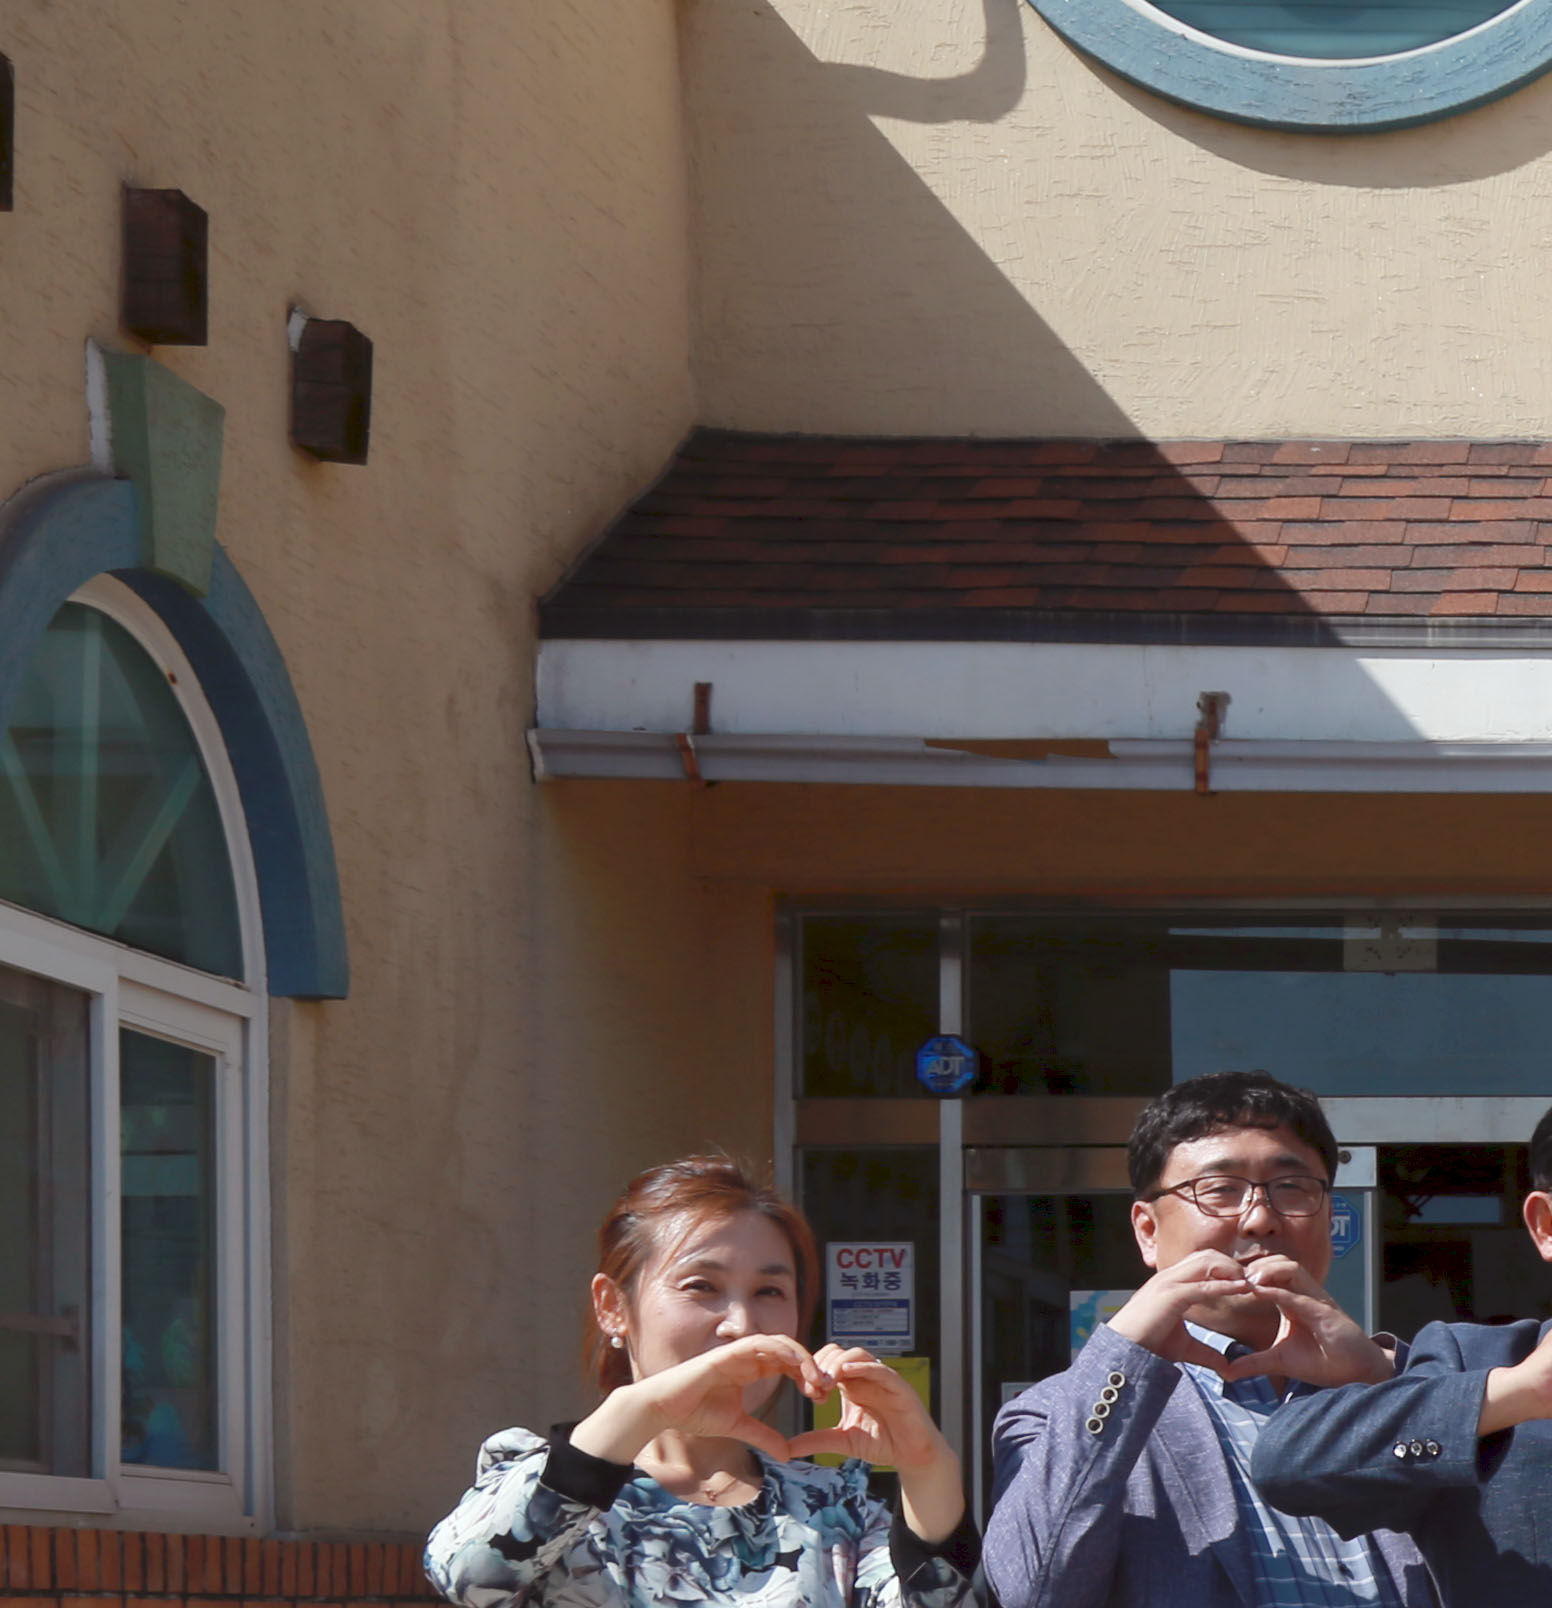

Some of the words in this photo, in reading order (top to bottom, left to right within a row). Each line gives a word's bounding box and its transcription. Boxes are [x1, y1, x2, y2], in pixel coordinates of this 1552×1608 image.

[928, 1056, 965, 1075] ADT
[836, 1248, 906, 1269] CCTV
[840, 1271, 901, 1291] 녹화중
